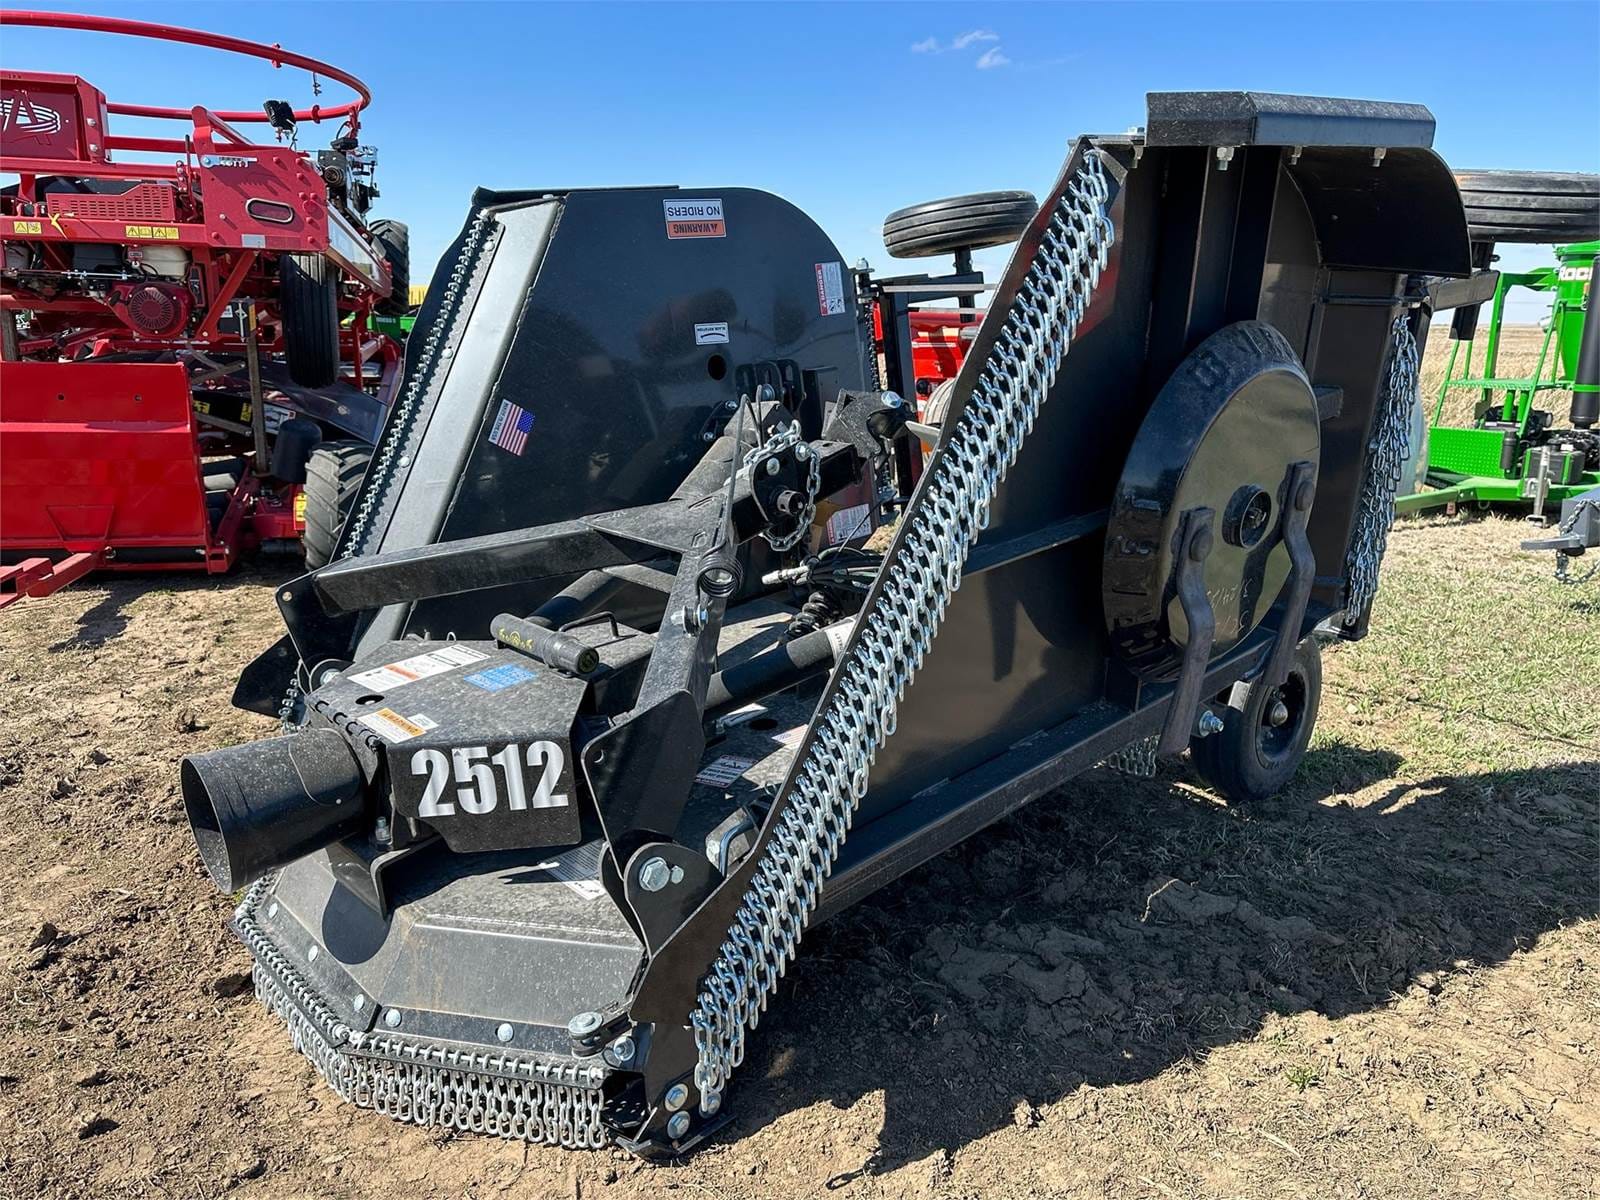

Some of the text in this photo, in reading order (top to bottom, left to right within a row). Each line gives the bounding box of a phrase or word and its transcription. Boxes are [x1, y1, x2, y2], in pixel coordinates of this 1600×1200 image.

[667, 206, 720, 216] NO RIDERS
[673, 223, 711, 234] WARNING
[411, 740, 569, 818] 2512
